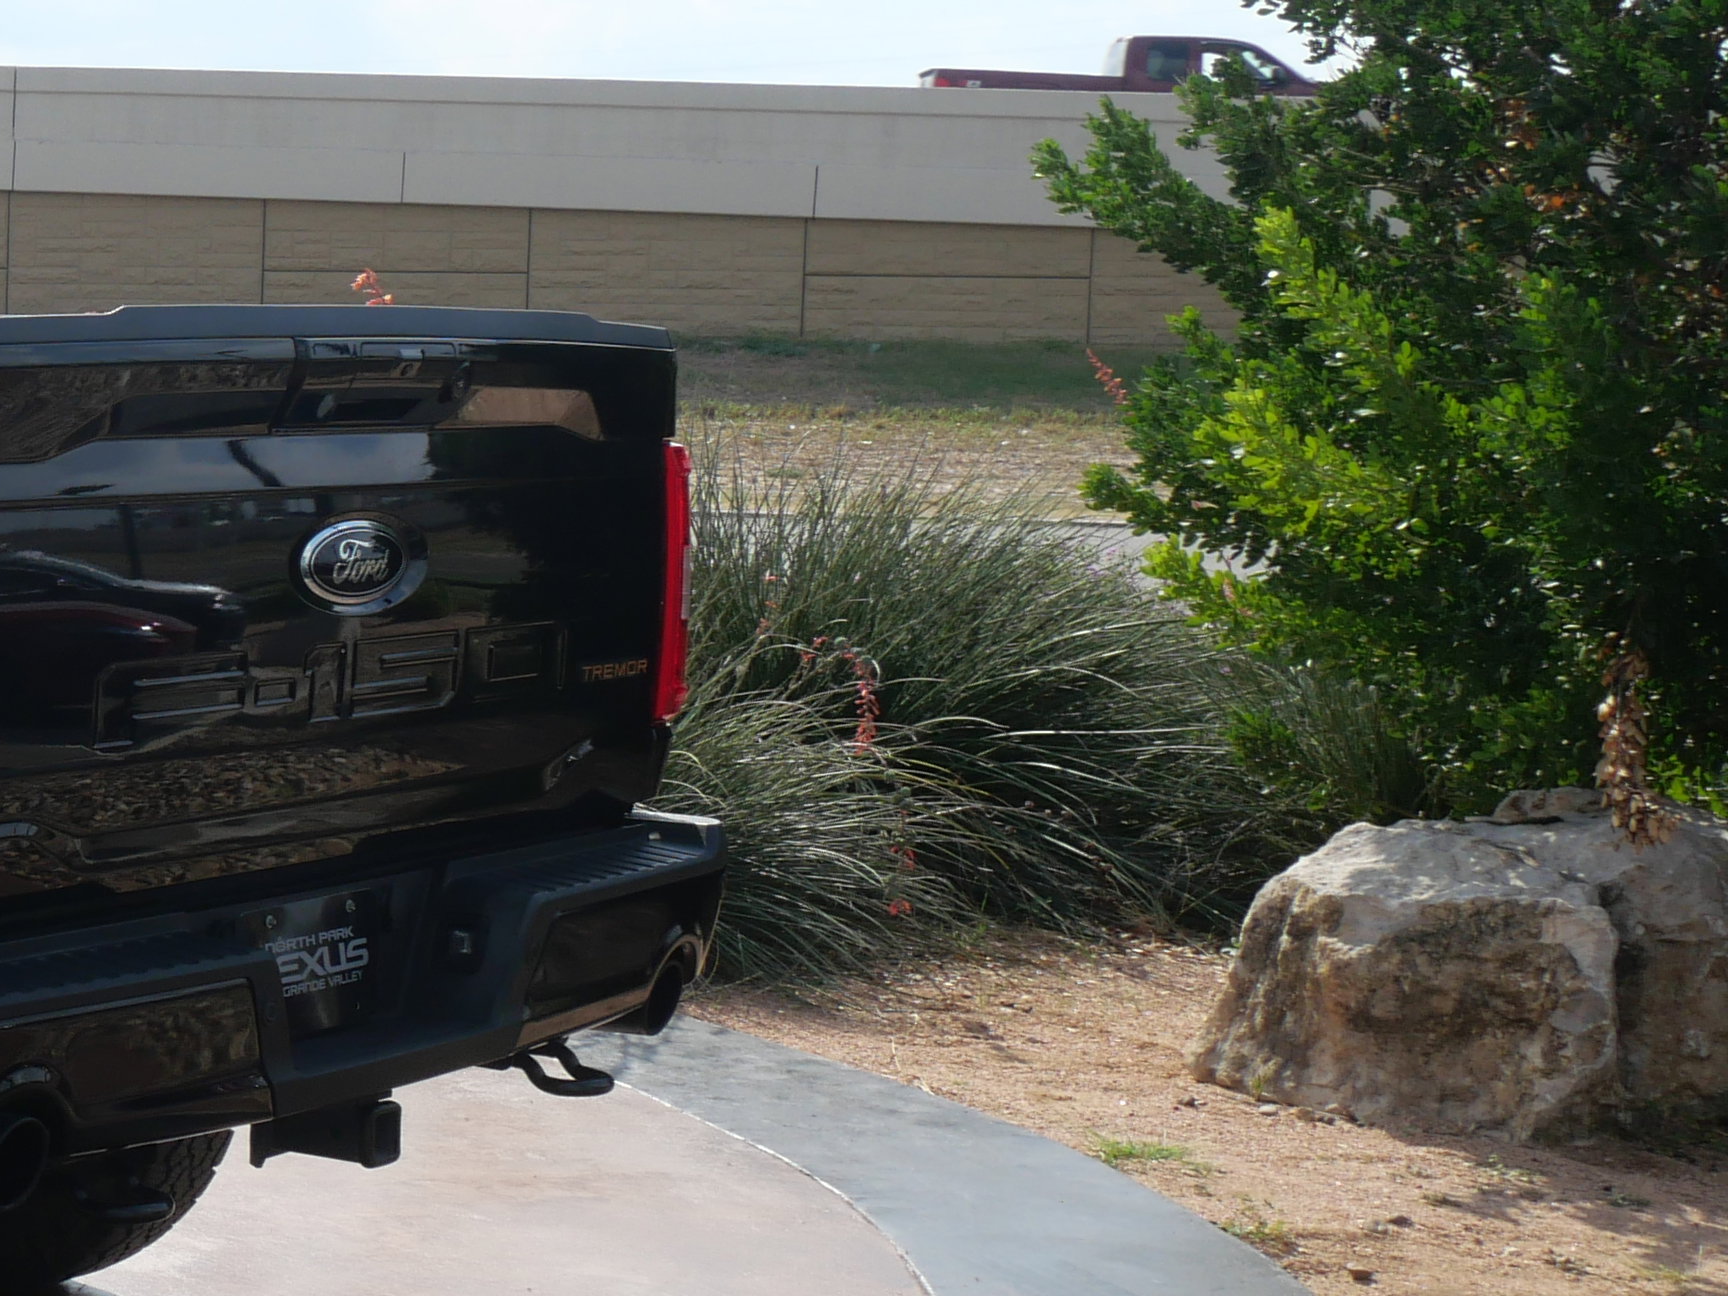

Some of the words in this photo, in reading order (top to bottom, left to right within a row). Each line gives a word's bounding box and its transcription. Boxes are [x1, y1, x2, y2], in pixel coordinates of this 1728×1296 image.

[332, 538, 390, 585] Ford
[92, 620, 568, 750] F-150
[581, 659, 649, 681] TREMOR
[264, 933, 316, 953] NORTH
[319, 925, 355, 944] PARK
[276, 937, 370, 985] EXUS
[282, 979, 327, 998] GRANDE
[327, 970, 364, 988] VALLEY
